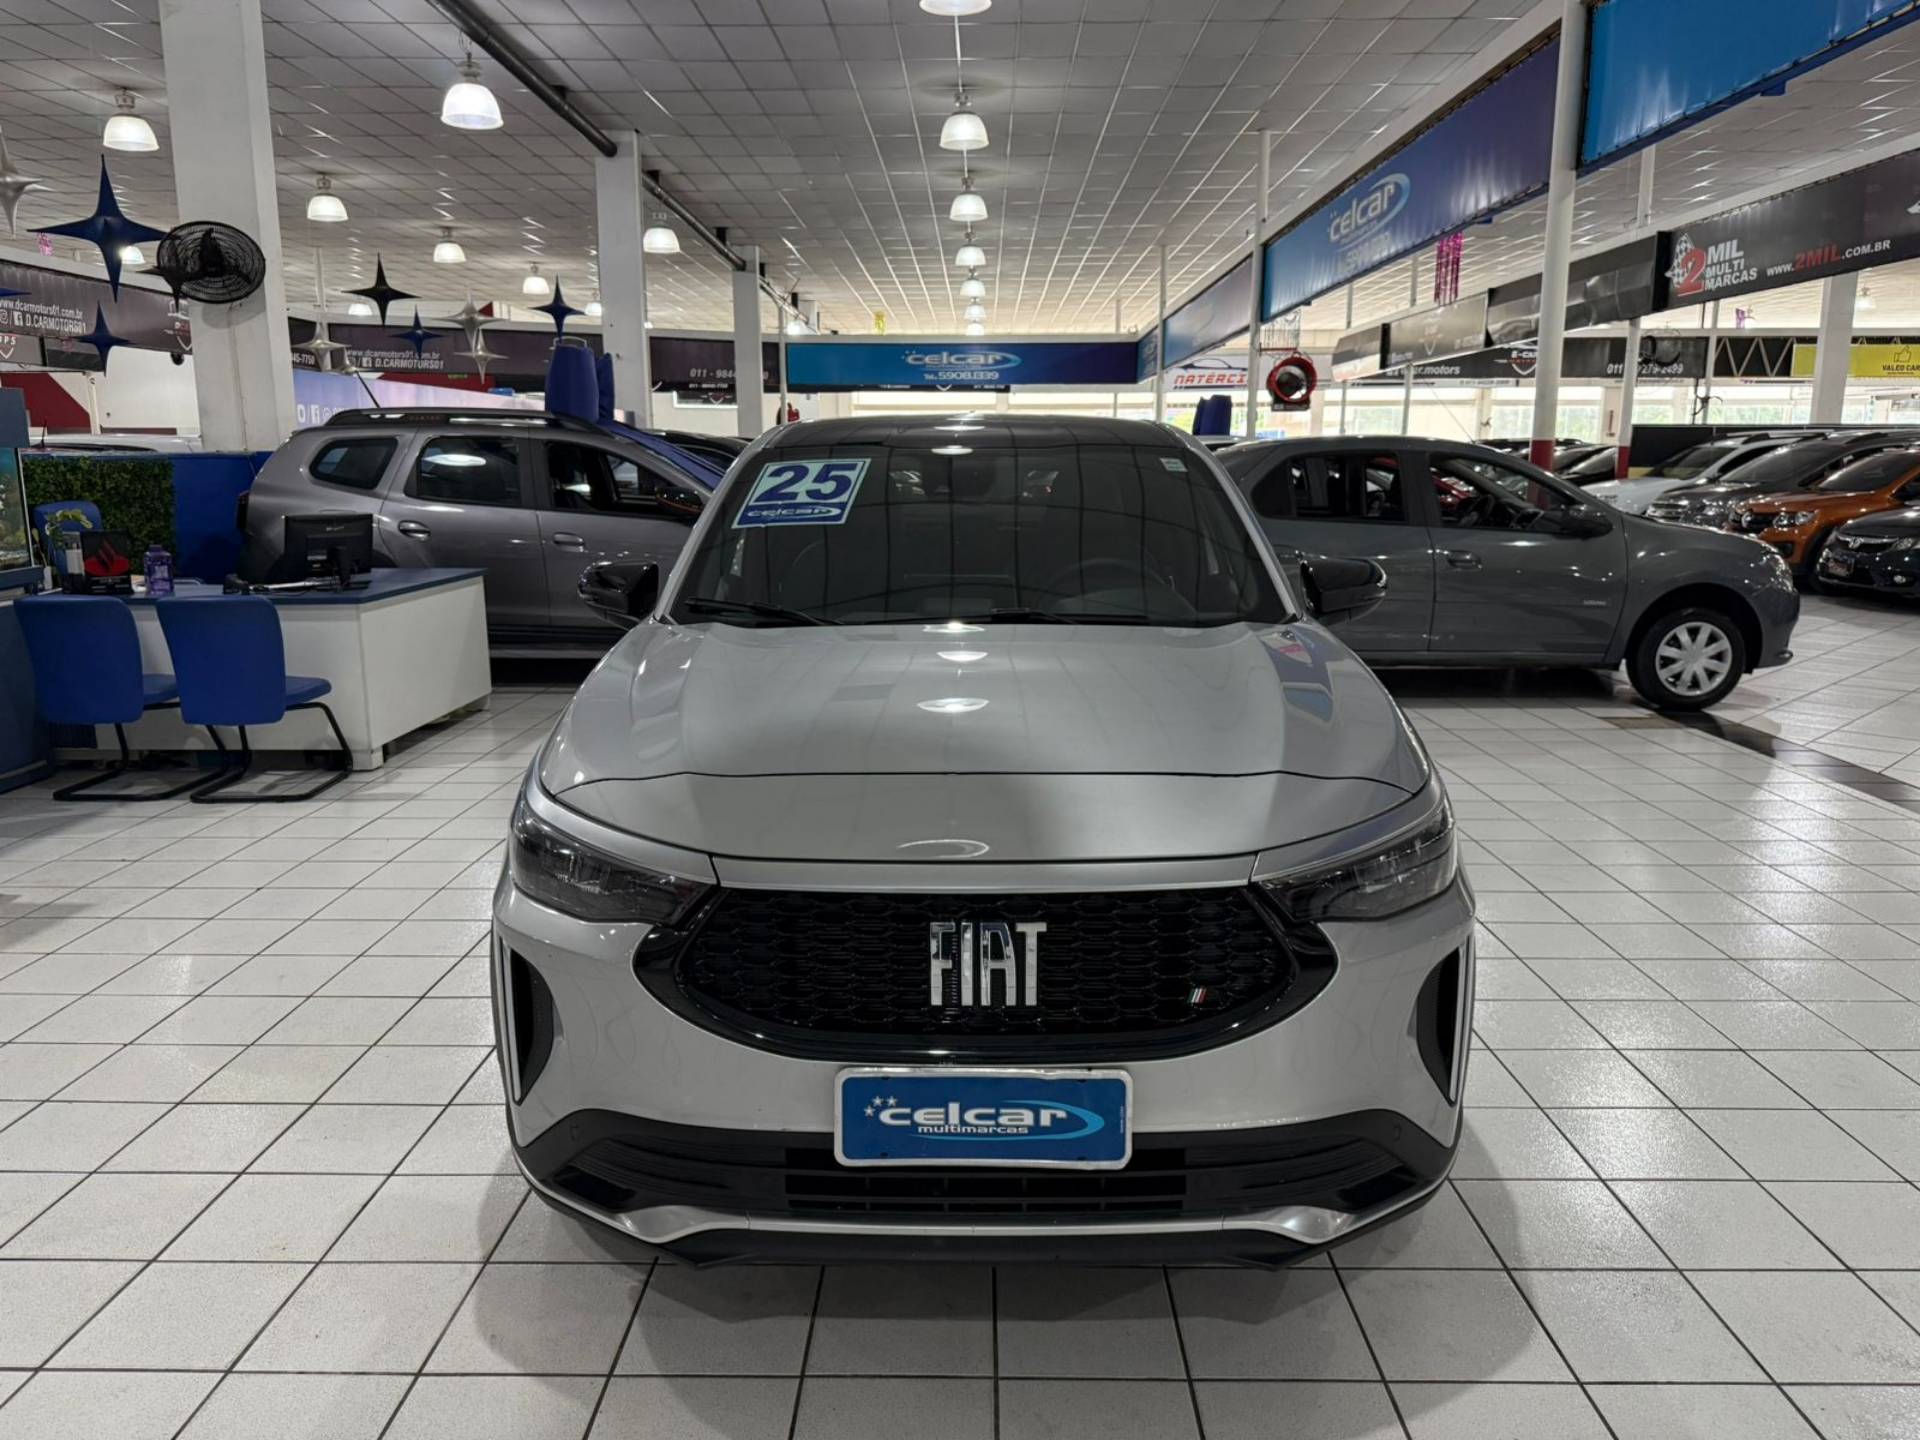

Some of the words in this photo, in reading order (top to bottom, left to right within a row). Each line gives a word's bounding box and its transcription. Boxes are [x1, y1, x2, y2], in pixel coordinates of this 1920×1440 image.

[1329, 183, 1395, 242] celcar
[1707, 239, 1744, 264] MIL
[1704, 267, 1758, 291] MARCAS
[1705, 258, 1745, 278] MULTI
[906, 351, 1001, 365] celcar
[753, 462, 858, 502] 25
[929, 922, 1048, 1007] FIAT
[878, 1101, 1068, 1127] celcar
[917, 1123, 1029, 1135] multimarcas
